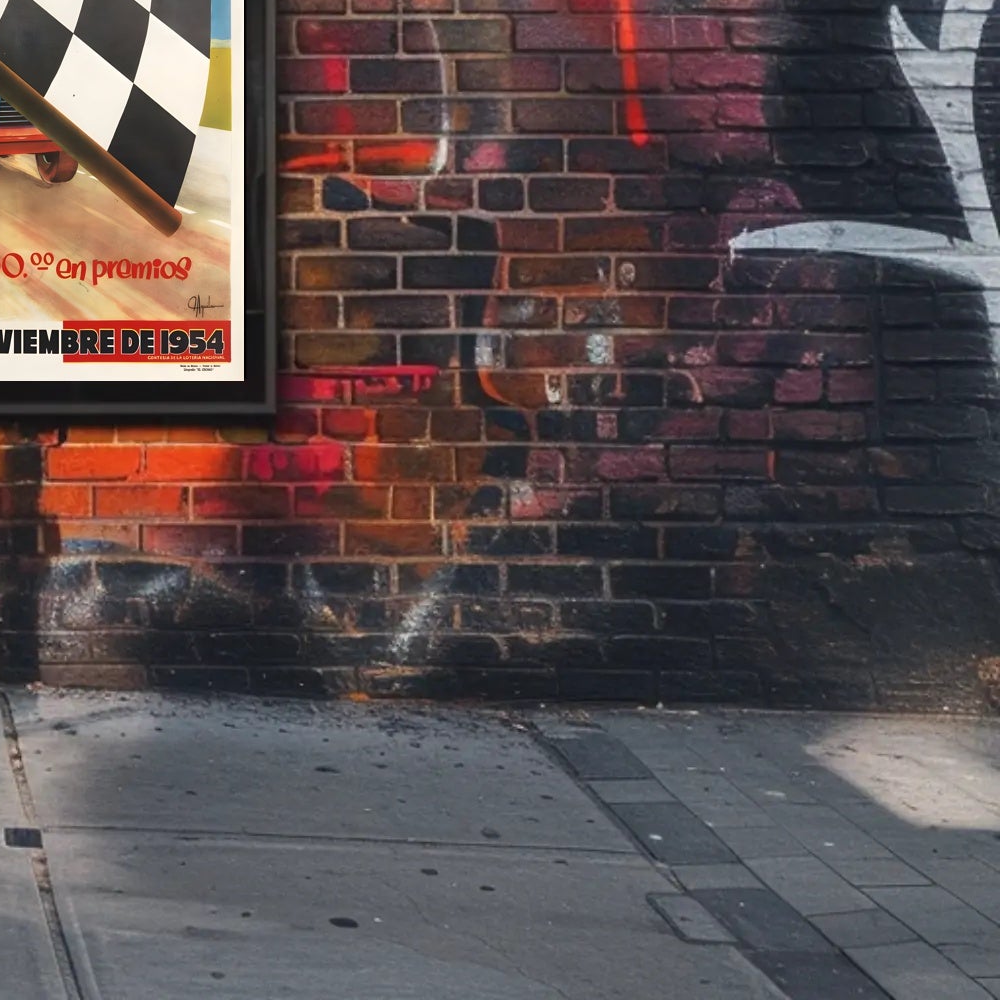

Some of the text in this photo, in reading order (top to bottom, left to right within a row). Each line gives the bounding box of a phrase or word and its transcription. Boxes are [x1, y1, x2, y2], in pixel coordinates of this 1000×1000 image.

[56, 258, 87, 280] en
[92, 256, 192, 285] premios
[120, 328, 155, 355] DE
[159, 328, 225, 355] 1954
